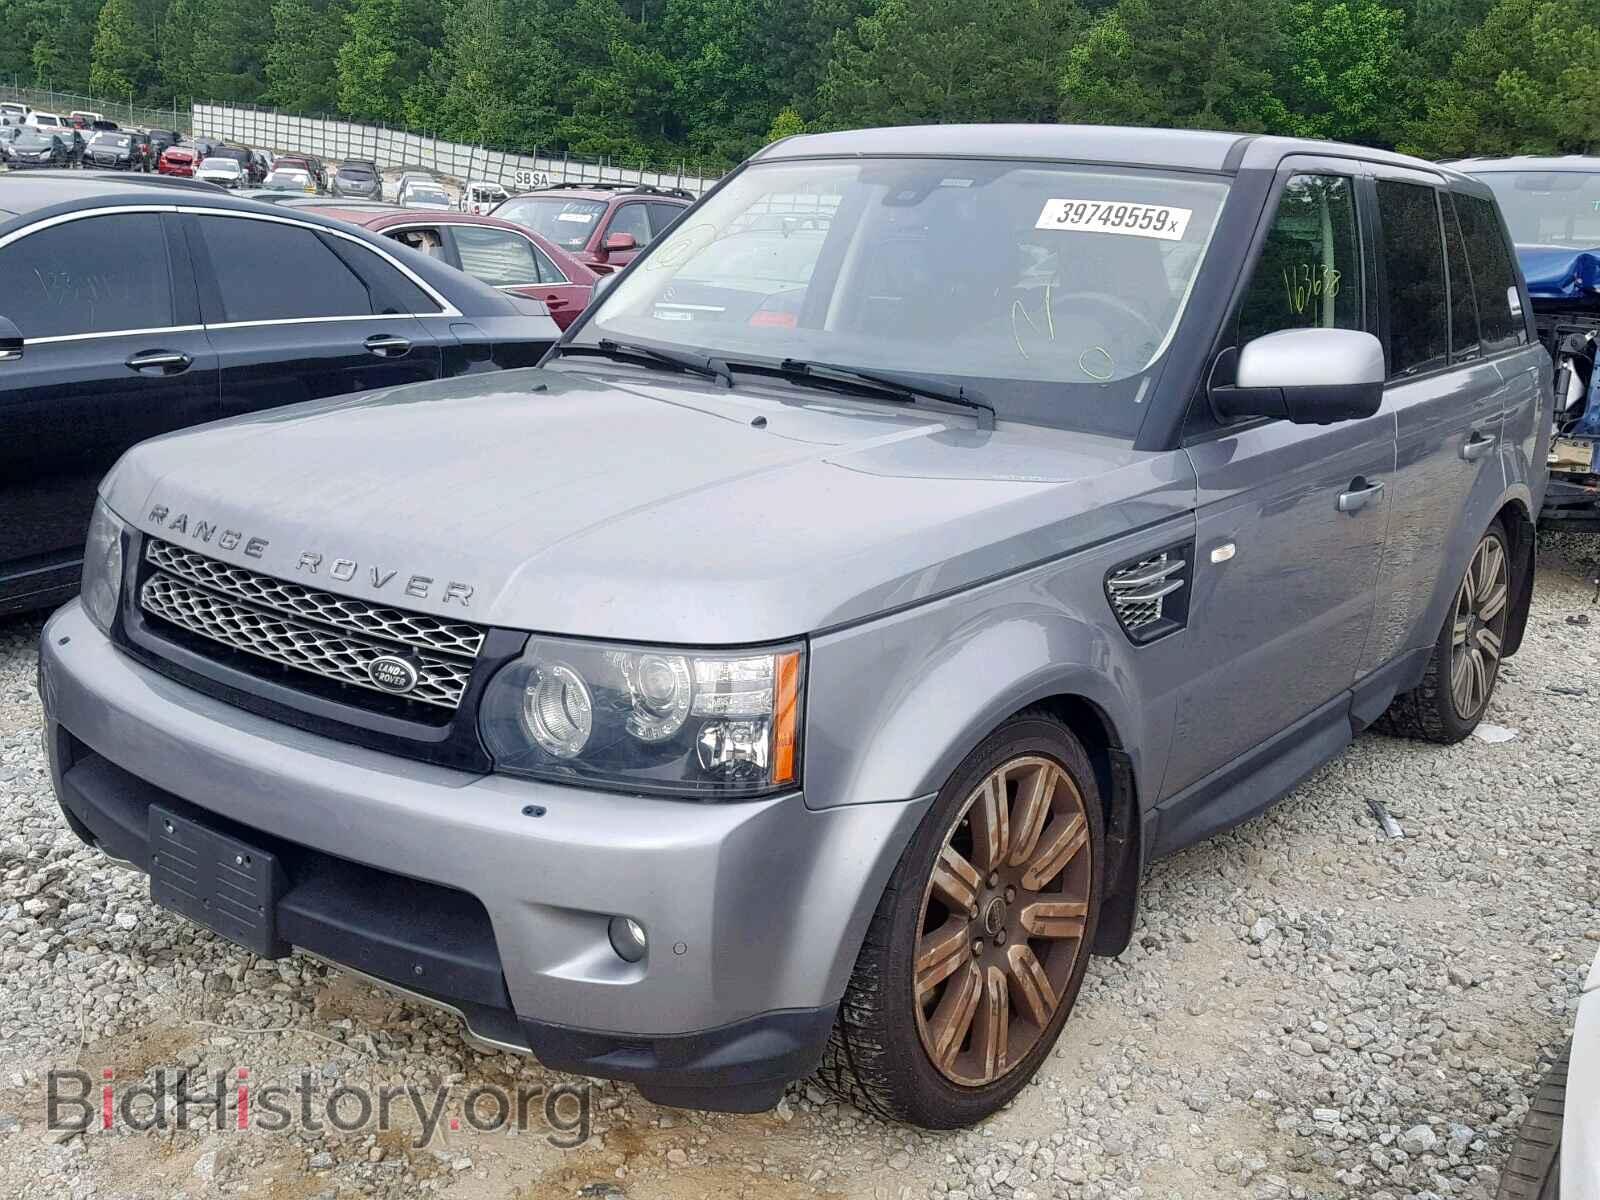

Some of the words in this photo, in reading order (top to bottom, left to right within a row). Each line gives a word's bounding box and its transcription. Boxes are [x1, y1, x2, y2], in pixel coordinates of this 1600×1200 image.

[148, 503, 270, 559] RANGE
[296, 551, 475, 608] ROVER
[378, 672, 406, 687] ROVER
